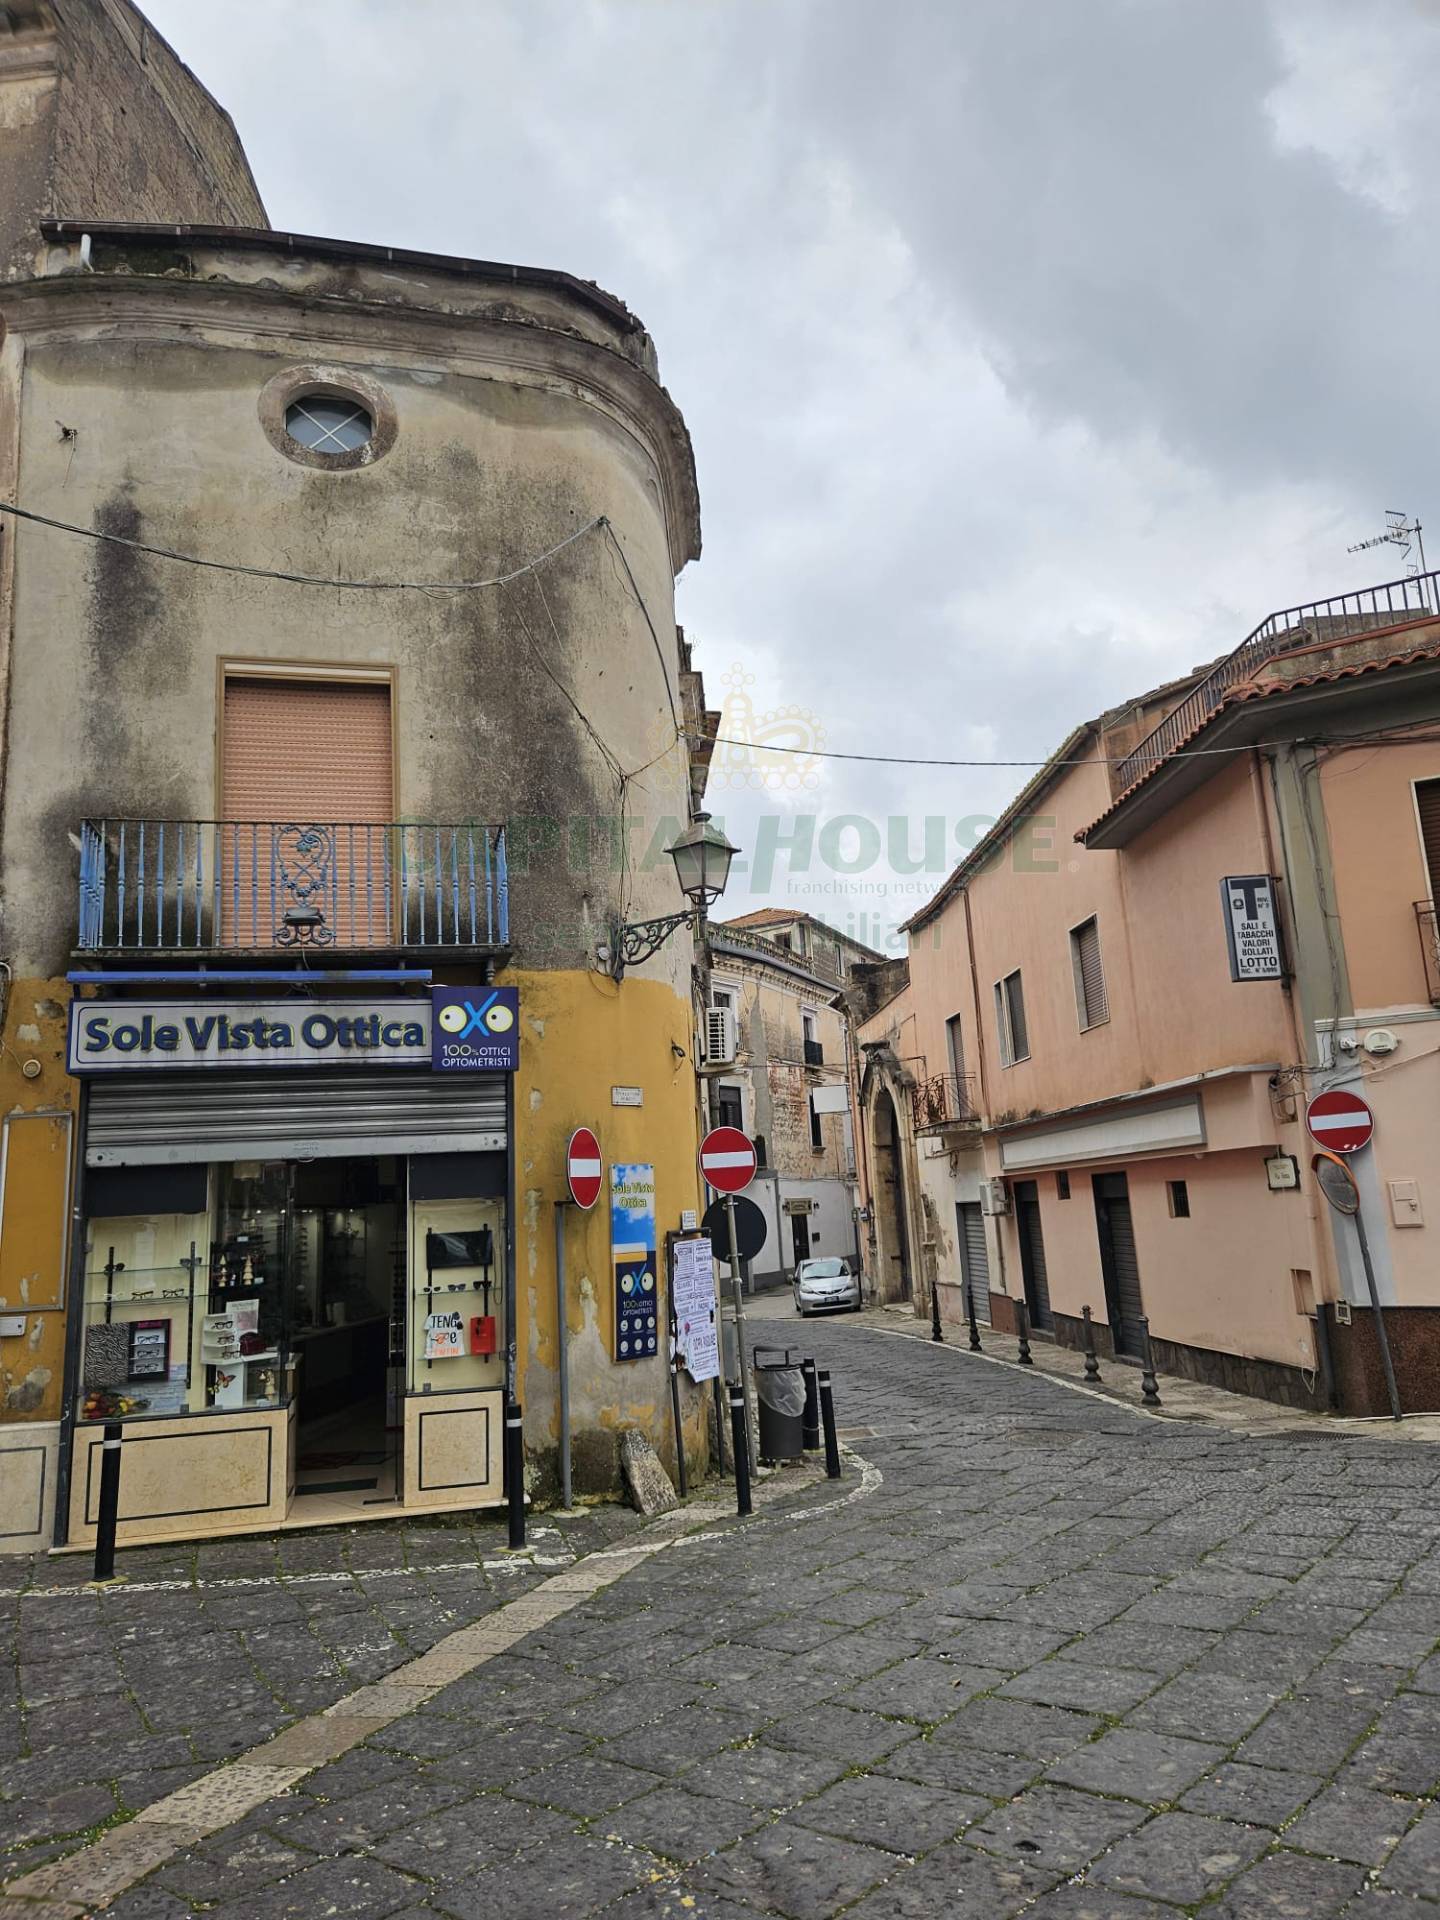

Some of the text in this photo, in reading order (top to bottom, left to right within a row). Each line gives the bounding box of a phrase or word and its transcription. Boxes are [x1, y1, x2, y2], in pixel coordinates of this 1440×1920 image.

[1241, 921, 1268, 930] SALI E
[1236, 929, 1274, 939] TABACCHI
[1242, 938, 1271, 948] VALORI
[1241, 947, 1274, 957] BOLLATI
[1239, 956, 1278, 968] LOTTO
[84, 1013, 427, 1052] Sole Vista Ottica
[479, 1046, 511, 1057] OTTICI
[441, 1057, 511, 1067] OPTOMETRISTI
[612, 1182, 631, 1194] Sole
[619, 1196, 648, 1209] Ottica
